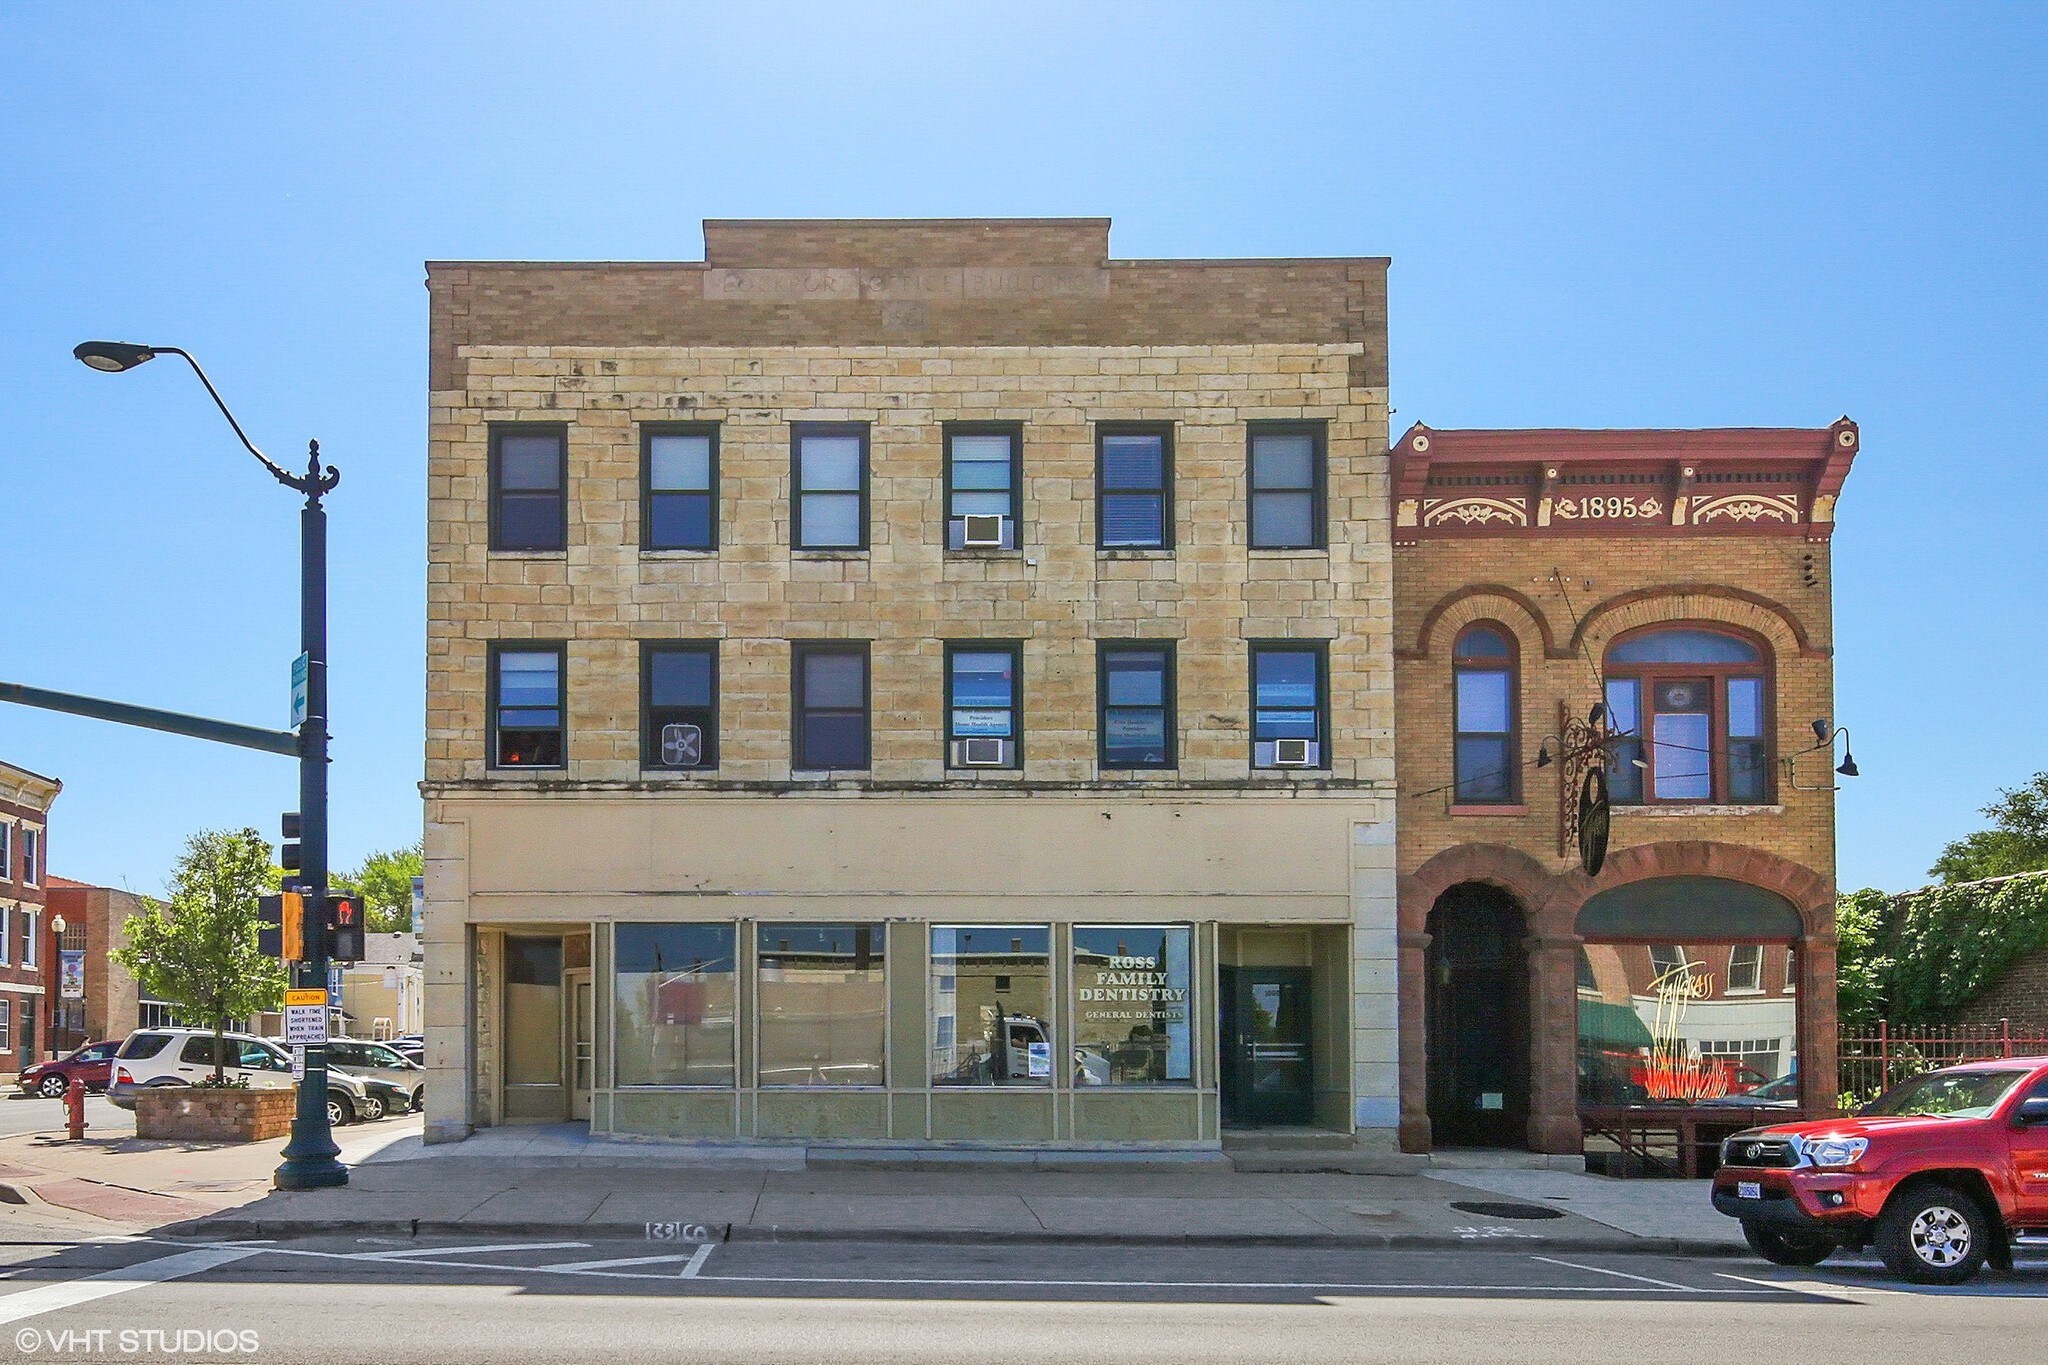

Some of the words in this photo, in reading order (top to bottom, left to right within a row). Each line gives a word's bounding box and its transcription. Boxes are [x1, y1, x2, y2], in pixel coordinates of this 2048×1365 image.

[868, 274, 952, 293] OFFICE
[973, 274, 1087, 293] BUILDING
[1580, 496, 1638, 519] 1895
[1109, 956, 1156, 969] ROSS
[1096, 972, 1168, 985] FAMILY
[1079, 988, 1186, 1001] DENTISTRY
[1086, 1011, 1132, 1019] GENERAL
